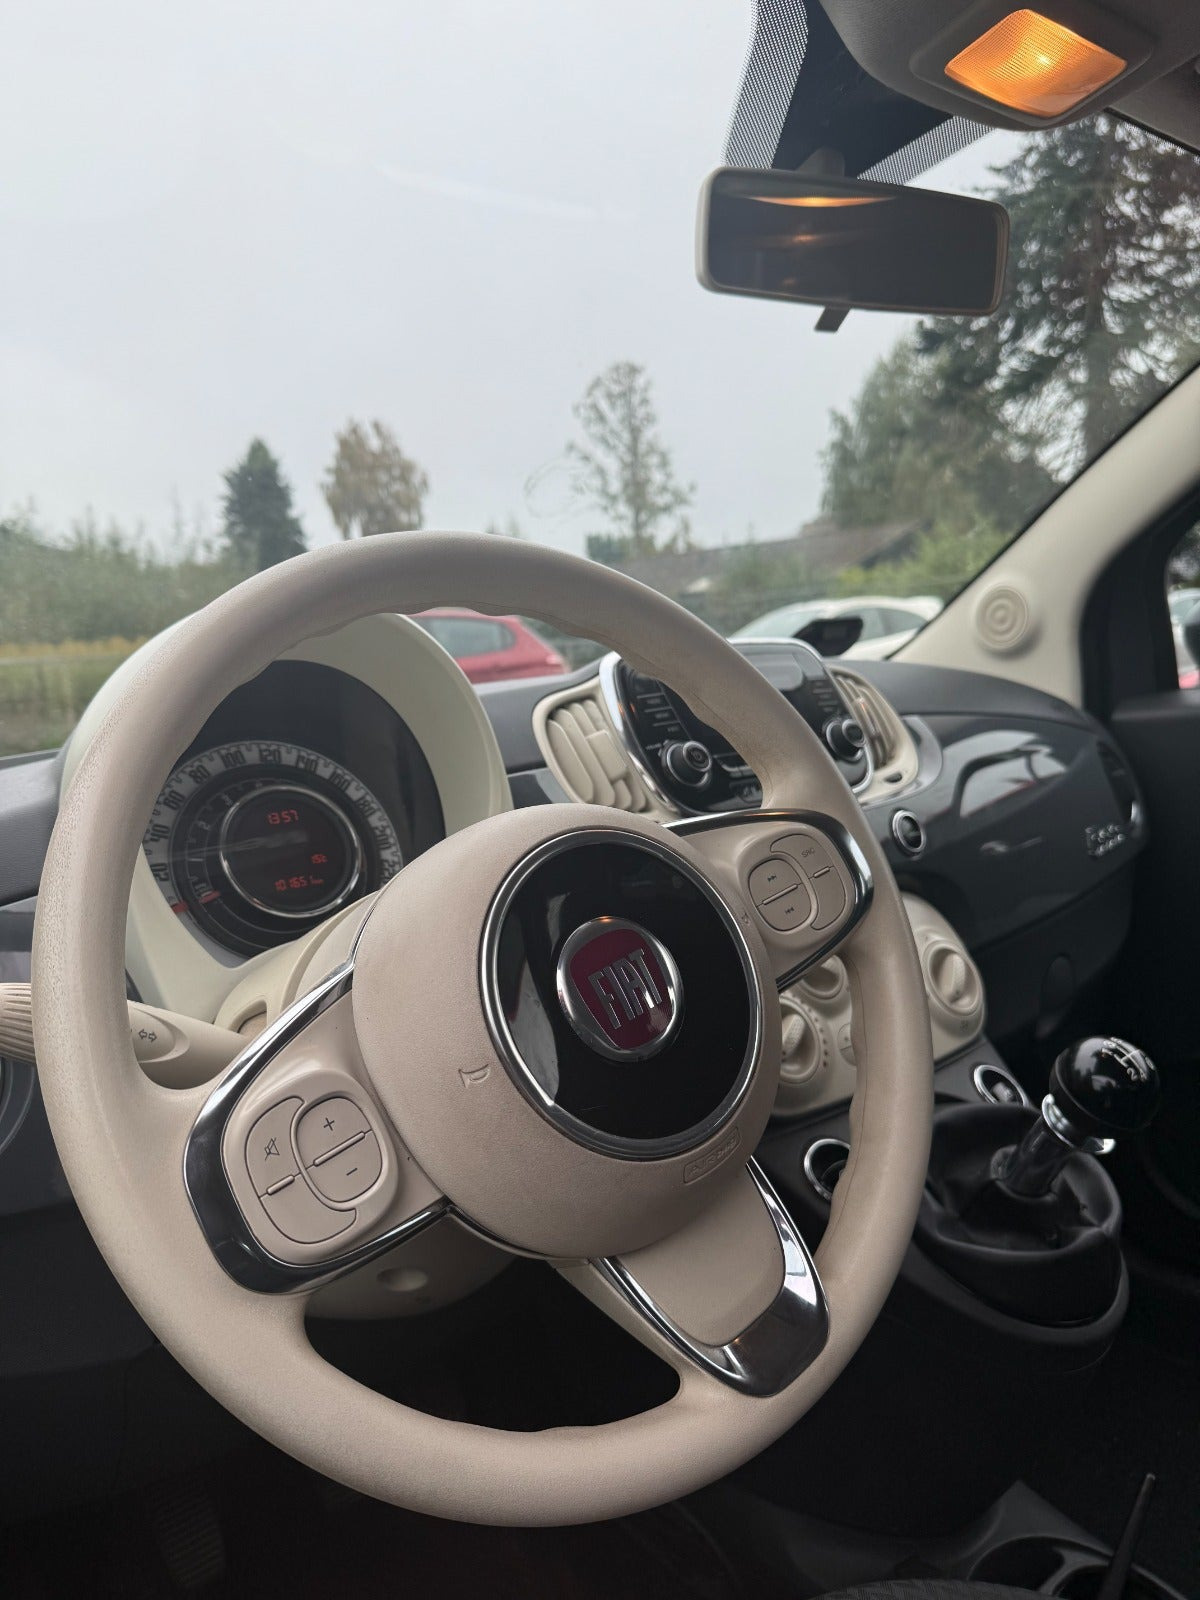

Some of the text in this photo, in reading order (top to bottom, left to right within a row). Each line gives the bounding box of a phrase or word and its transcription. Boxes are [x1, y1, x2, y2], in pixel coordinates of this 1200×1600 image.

[220, 749, 245, 769] 100
[260, 750, 281, 765] 120
[191, 765, 211, 784] 80
[330, 772, 350, 791] 160
[164, 791, 185, 811] 60
[356, 796, 376, 817] 180
[151, 824, 170, 843] 40
[587, 947, 663, 1030] FIAT
